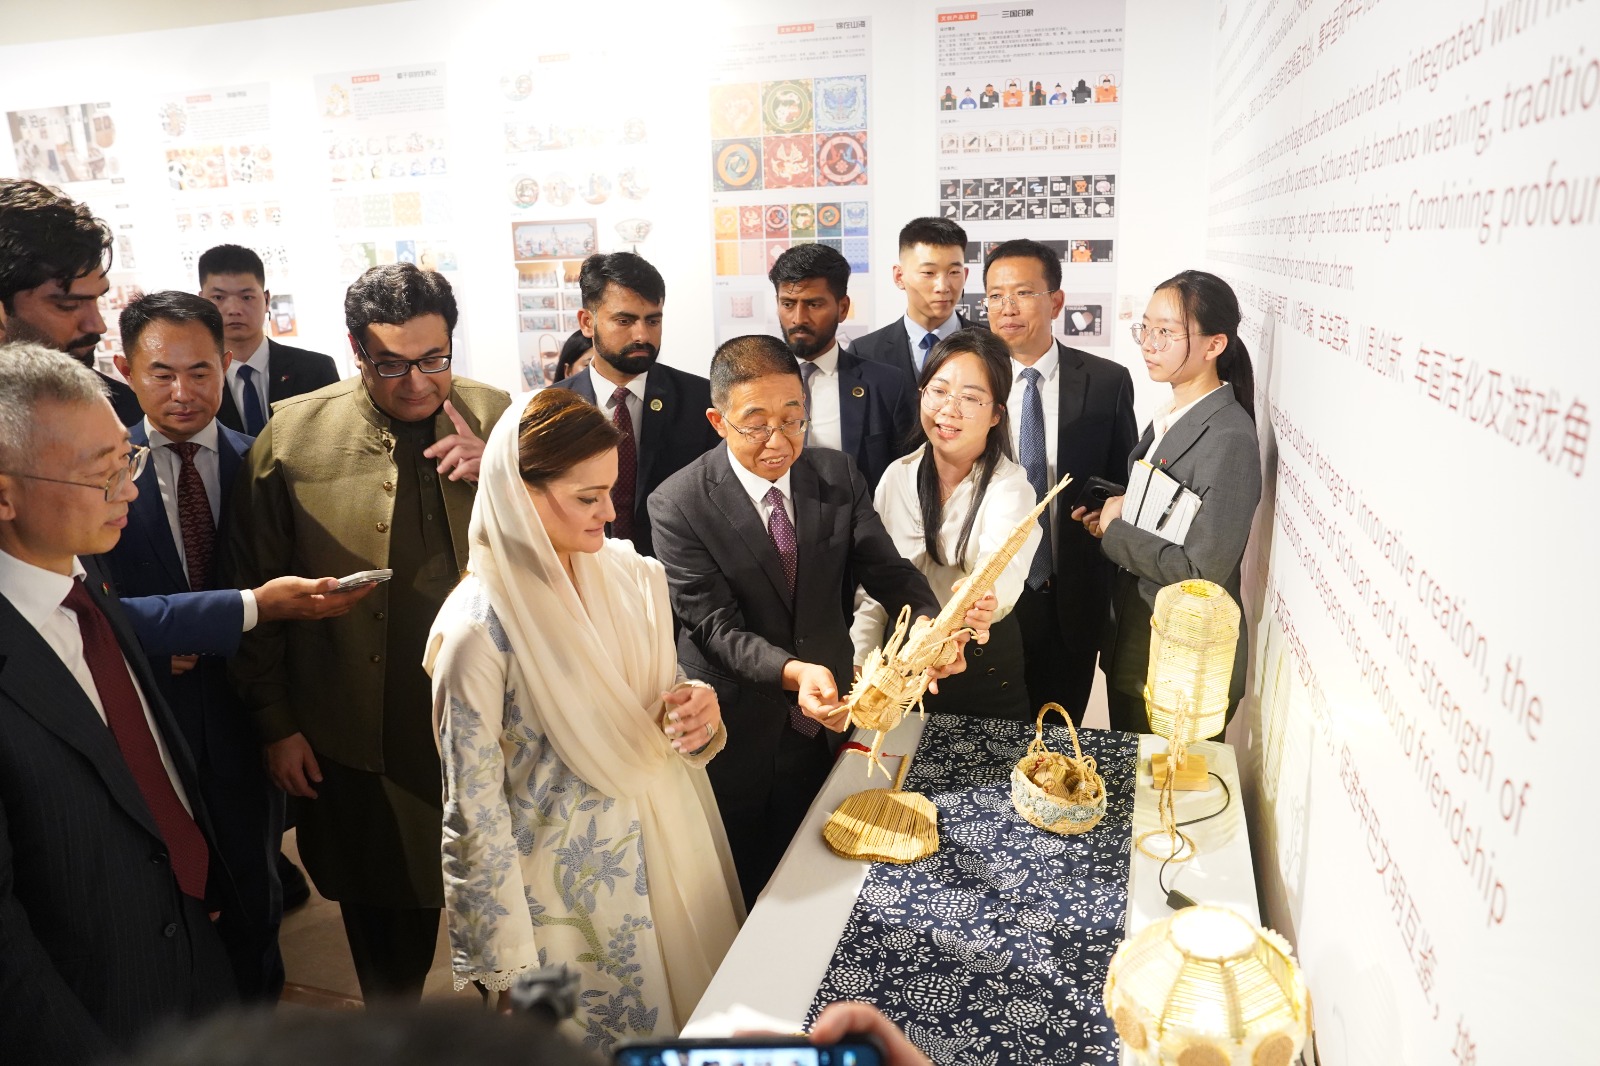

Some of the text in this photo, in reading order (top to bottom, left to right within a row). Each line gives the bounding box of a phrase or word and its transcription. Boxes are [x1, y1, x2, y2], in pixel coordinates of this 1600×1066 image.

[1001, 8, 1034, 18] 三国印象
[1320, 98, 1334, 136] and
[1334, 69, 1378, 128] traditional
[1378, 65, 1402, 106] arts,
[1406, 0, 1488, 92] integrated
[1319, 135, 1369, 185] Sichuan-style
[1371, 121, 1419, 170] bamboo
[1423, 94, 1493, 156] weaving,
[1298, 205, 1308, 234] and
[1308, 212, 1326, 242] game
[1327, 200, 1365, 234] character
[1365, 193, 1402, 243] design.
[1408, 179, 1495, 244] Combining
[1305, 252, 1328, 285] modern
[1328, 254, 1354, 290] charm.
[1293, 425, 1315, 468] cultural
[1315, 442, 1344, 507] heritage
[1346, 480, 1356, 516] to
[1358, 489, 1415, 587] innovative
[1418, 570, 1490, 694] creation,
[1502, 653, 1544, 742] the
[1301, 480, 1326, 541] features
[1327, 520, 1337, 553] of
[1336, 530, 1371, 606] Sichuan
[1372, 590, 1397, 639] and
[1395, 615, 1417, 677] the
[1419, 659, 1495, 793] strength
[1500, 778, 1532, 836] of
[1303, 546, 1317, 580] and
[1316, 560, 1346, 636] deepens
[1346, 613, 1362, 663] the
[1360, 648, 1416, 759] profound
[1415, 730, 1508, 928] friendship
